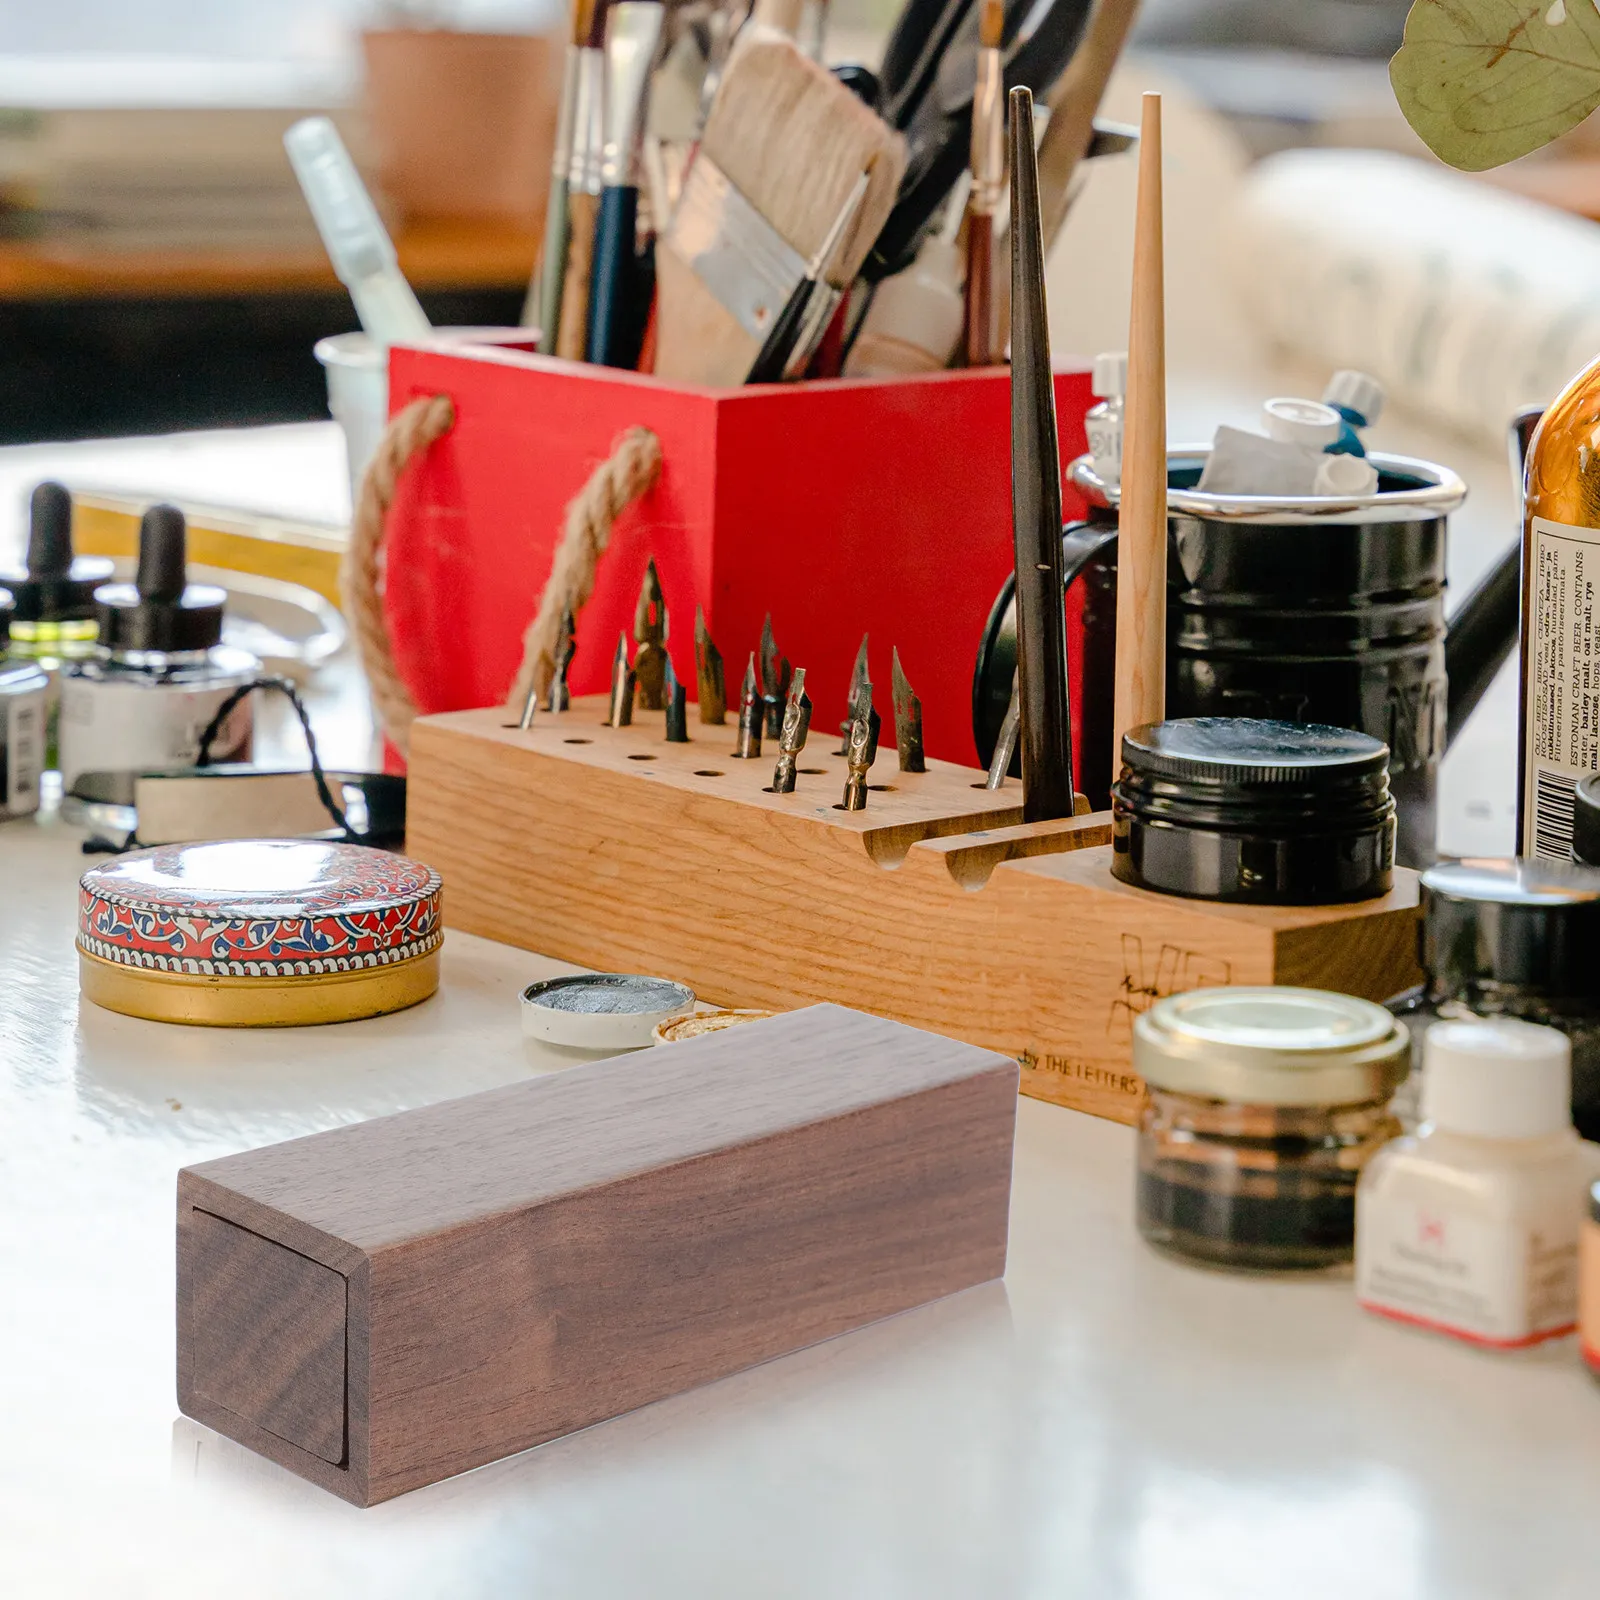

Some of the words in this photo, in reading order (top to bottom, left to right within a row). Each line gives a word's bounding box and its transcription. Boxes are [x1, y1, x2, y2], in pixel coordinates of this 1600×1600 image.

[1546, 552, 1552, 563] ja
[1575, 549, 1583, 616] CONTAINS:
[1585, 581, 1595, 601] rye
[1583, 604, 1593, 634] malt,
[1557, 671, 1565, 683] ja
[1572, 656, 1581, 698] CRAFT
[1582, 659, 1591, 689] malt,
[1554, 686, 1562, 762] Filtreerimata
[1580, 692, 1591, 729] barley
[1570, 702, 1579, 766] ESTONIAN
[1023, 1049, 1039, 1070] by
[1045, 1053, 1071, 1076] THE
[1076, 1064, 1138, 1095] LETTERS
